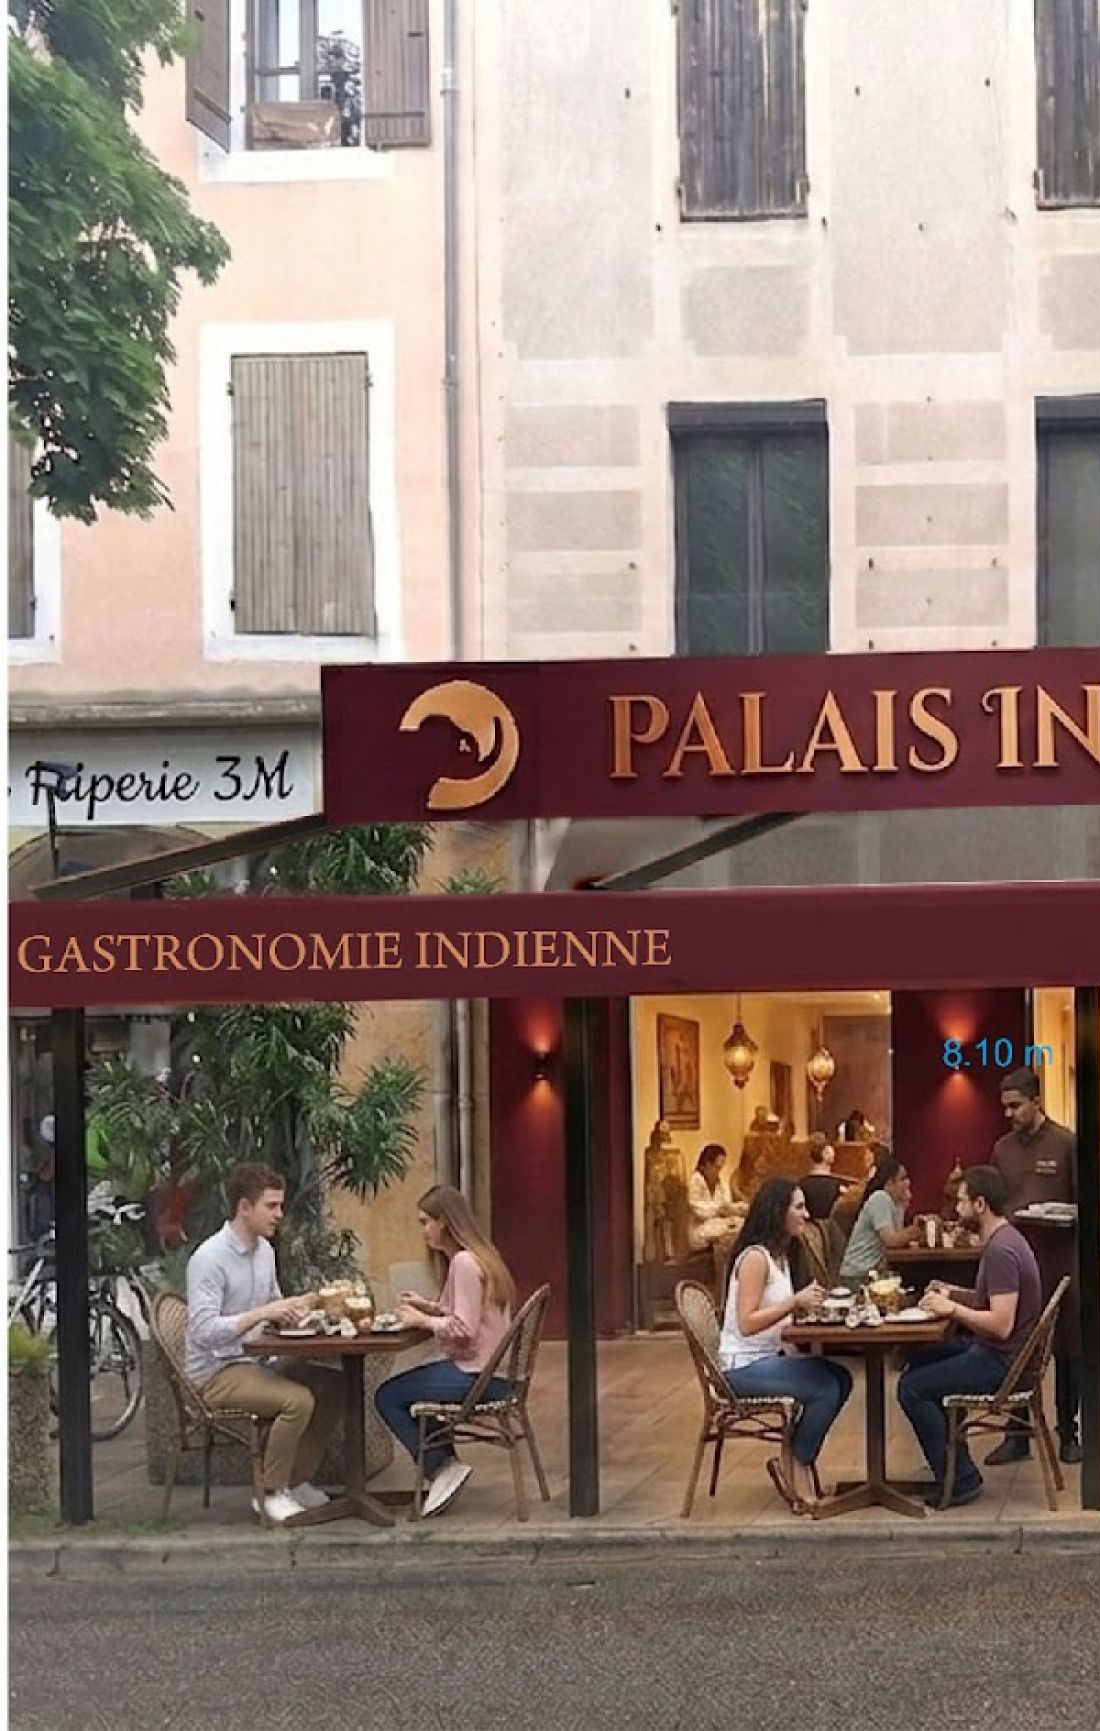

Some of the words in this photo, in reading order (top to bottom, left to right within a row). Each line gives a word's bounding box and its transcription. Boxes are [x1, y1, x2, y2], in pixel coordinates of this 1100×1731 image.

[609, 688, 959, 778] PALAIS
[213, 750, 294, 801] 3M
[17, 932, 403, 974] GASTRONOMIE
[415, 928, 673, 970] INDIENNE
